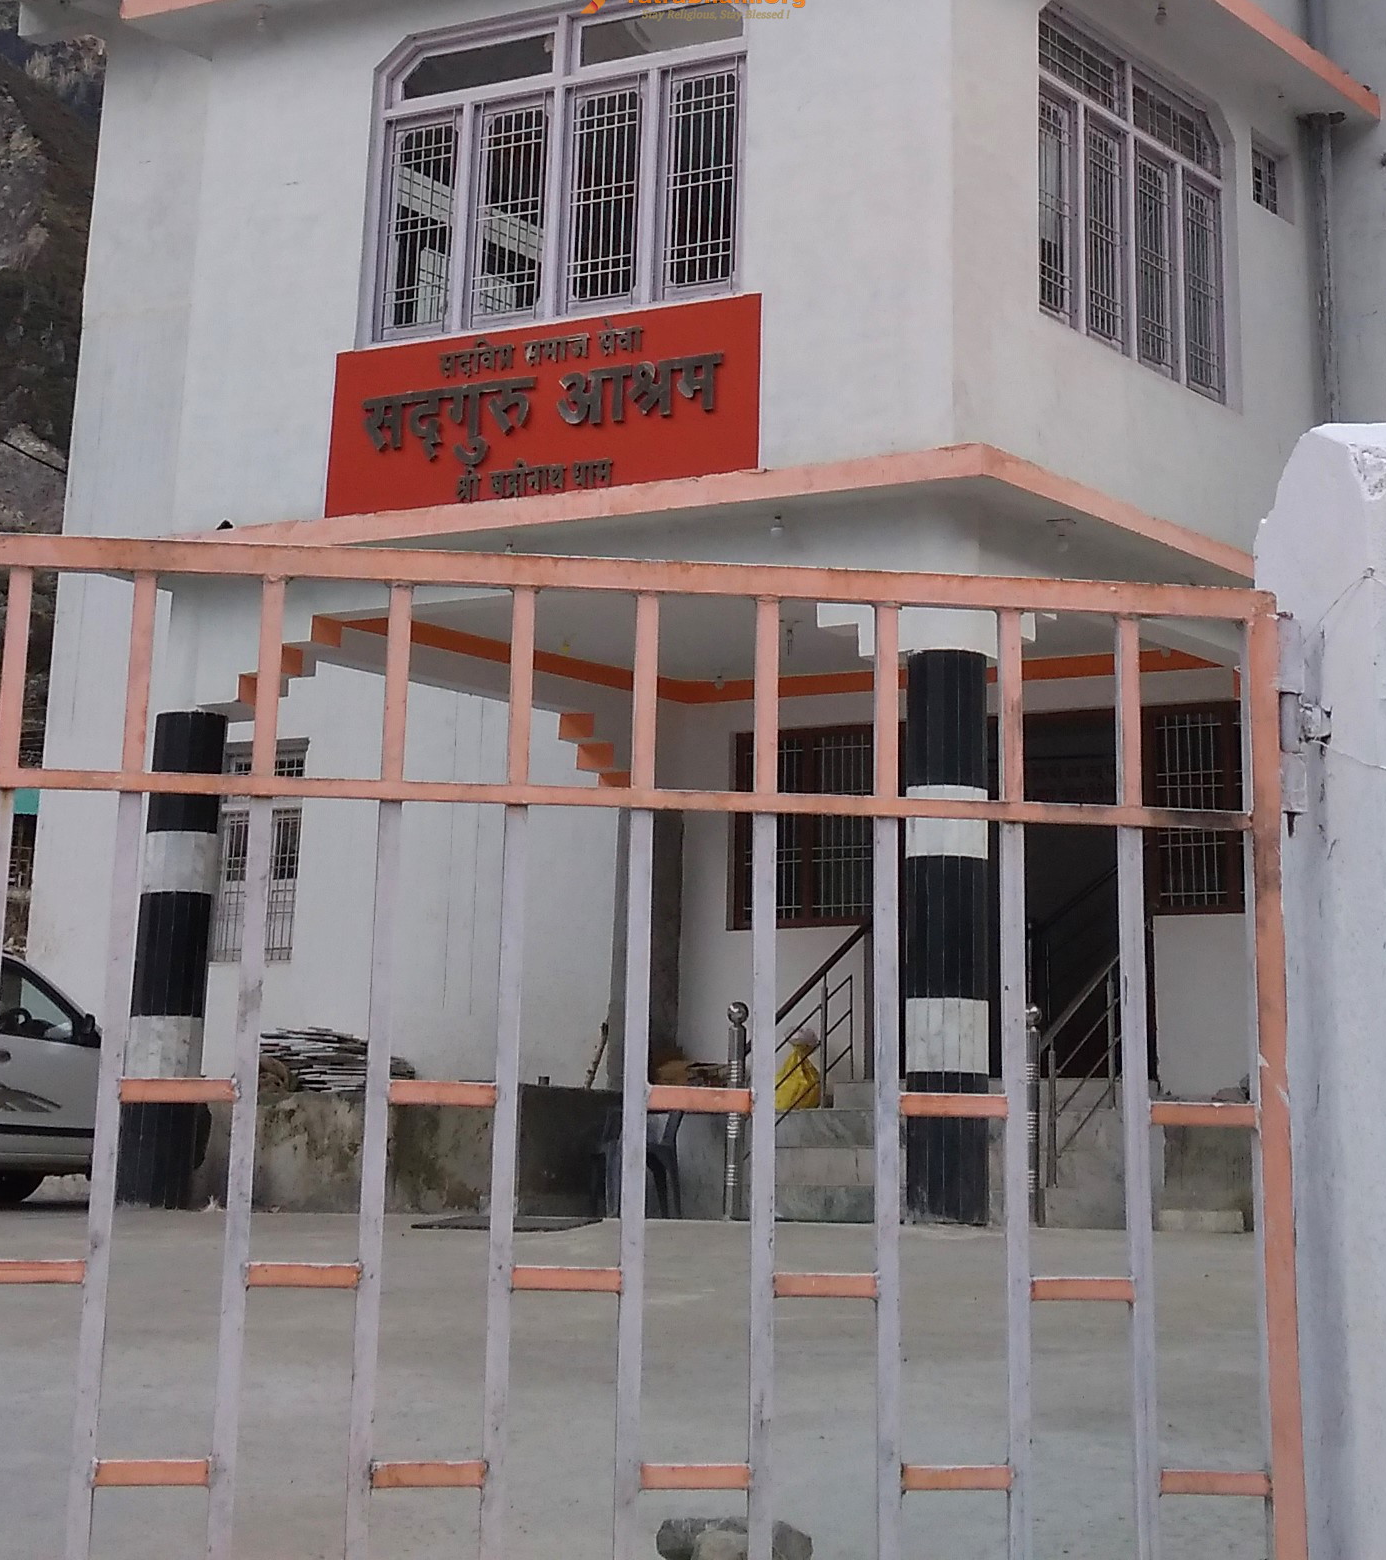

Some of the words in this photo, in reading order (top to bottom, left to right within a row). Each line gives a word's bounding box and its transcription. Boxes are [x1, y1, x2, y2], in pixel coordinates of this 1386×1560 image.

[522, 332, 590, 367] समाज
[596, 319, 644, 357] सेवा
[362, 375, 538, 466] सद्गुरु
[555, 351, 724, 427] आश्रम
[456, 462, 481, 503] श्री
[489, 459, 566, 499] बद्रीनाथ
[572, 458, 613, 489] धाम
